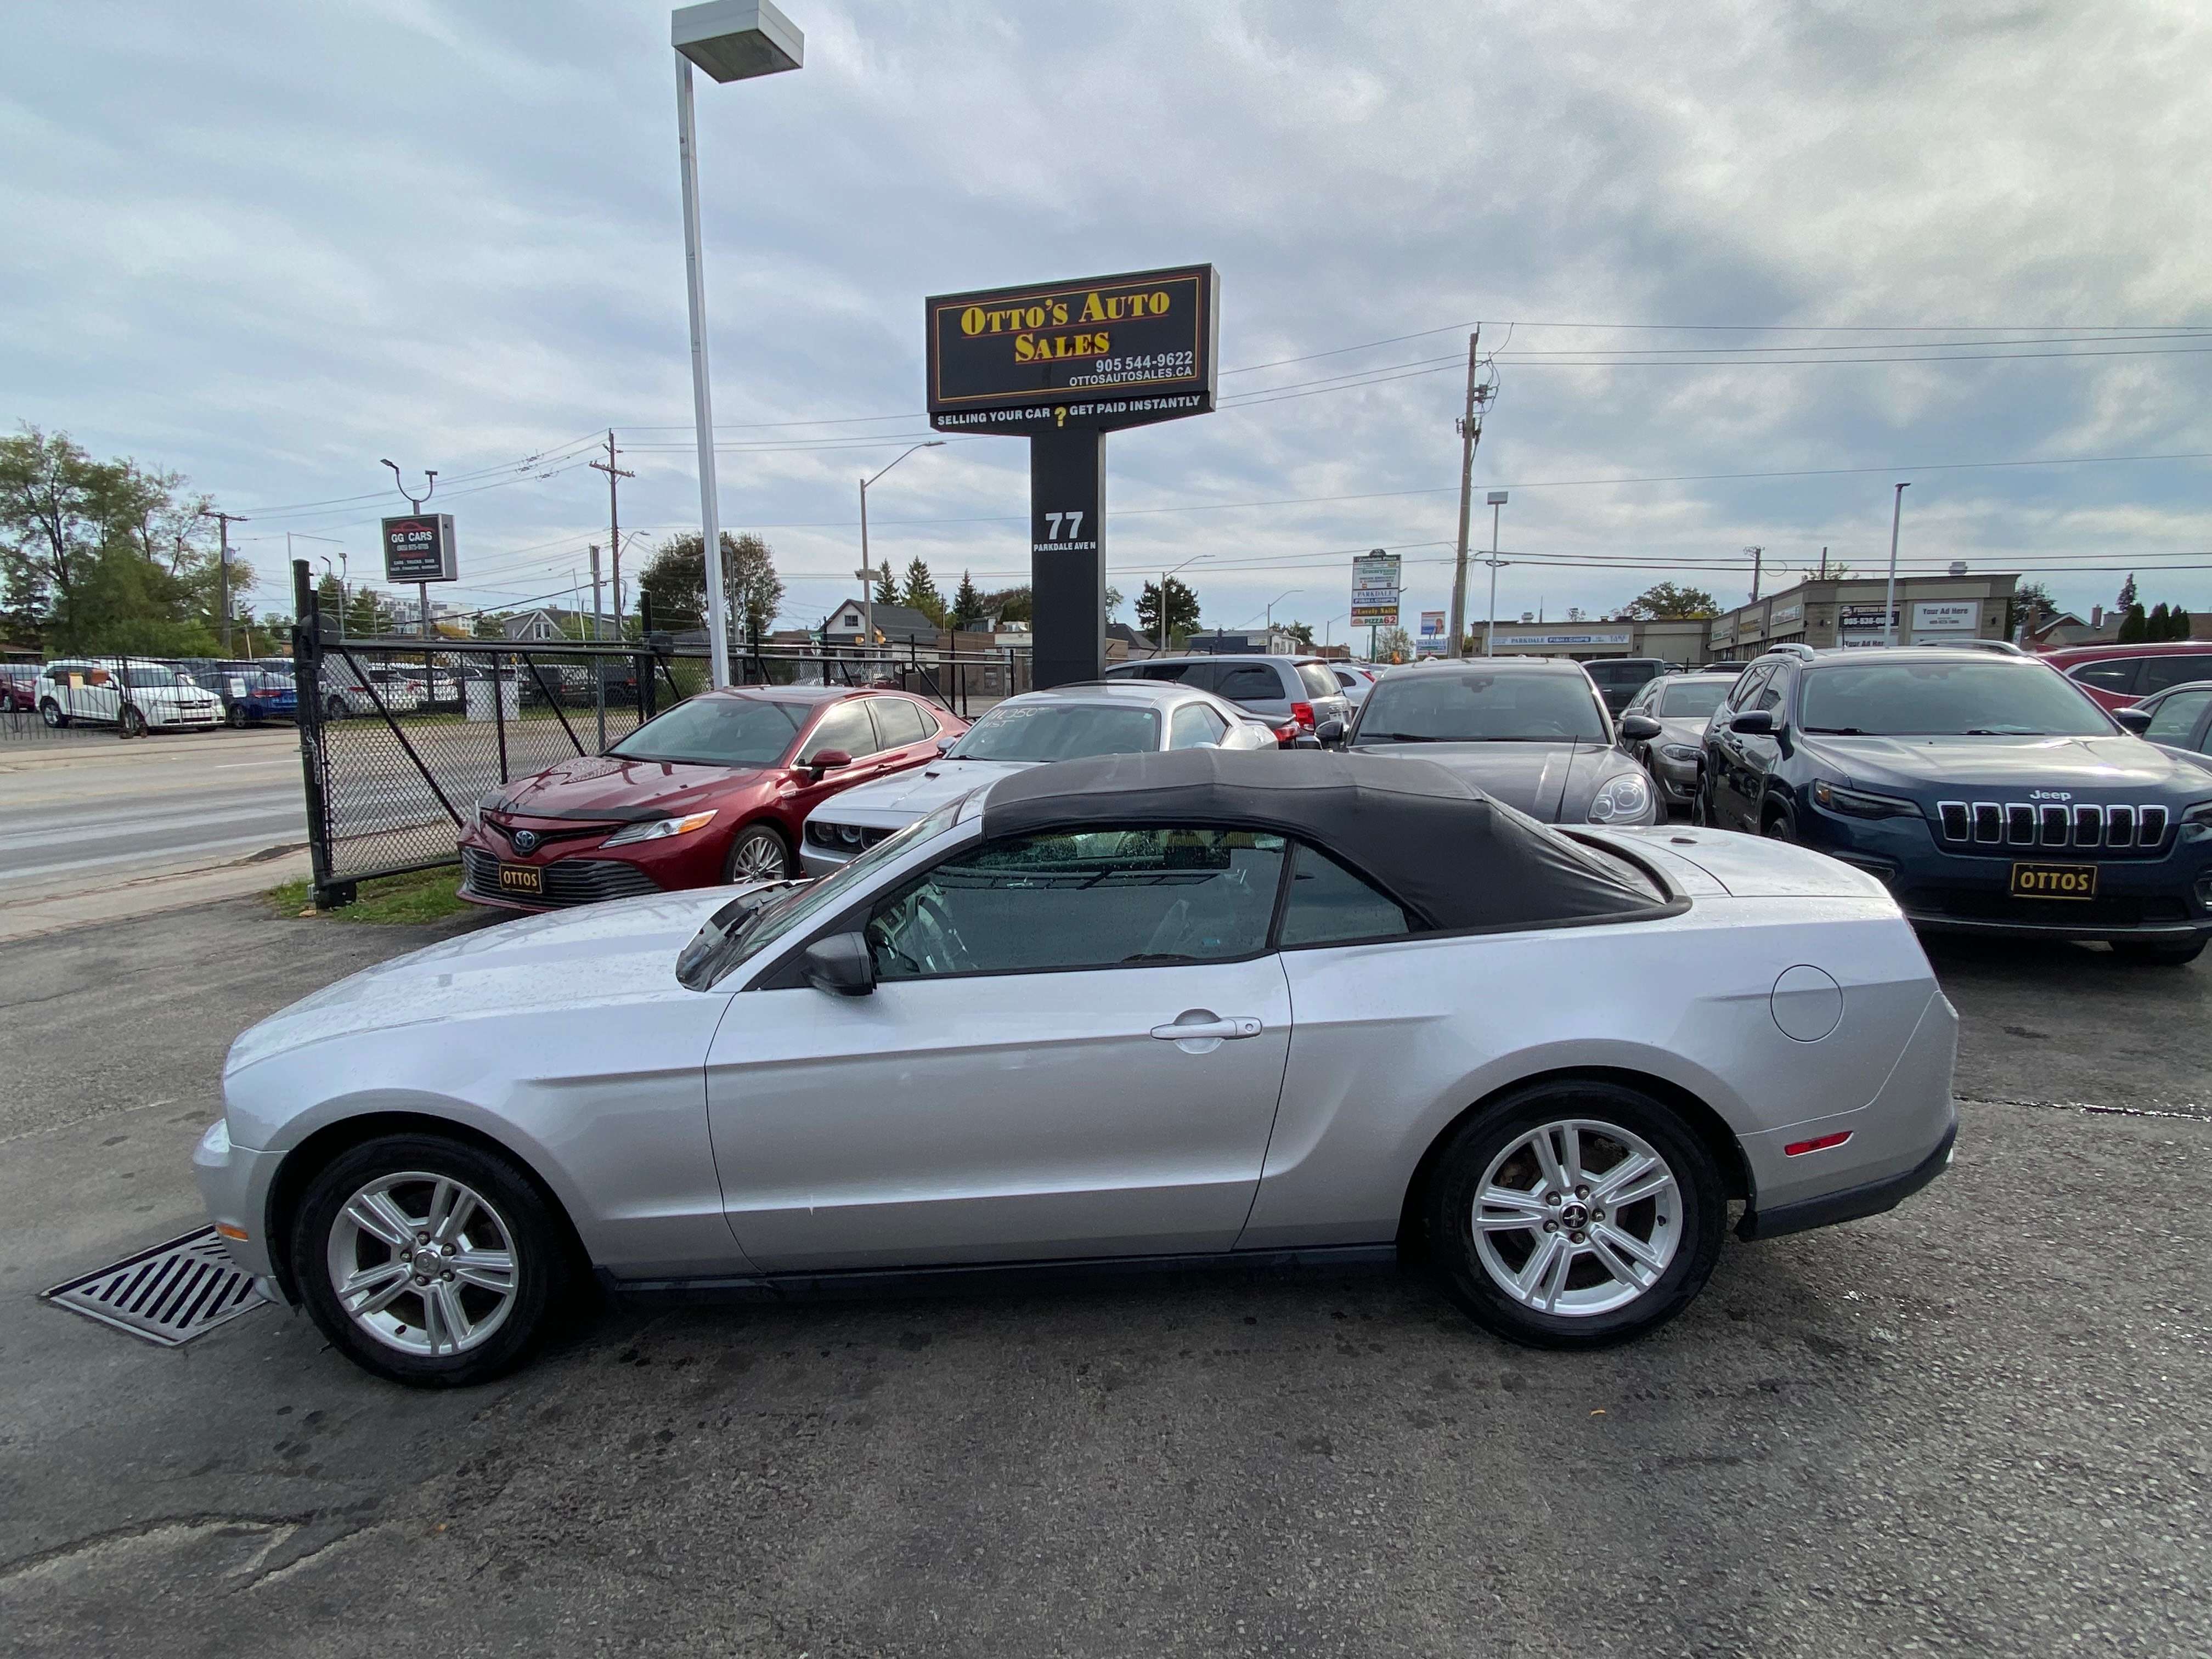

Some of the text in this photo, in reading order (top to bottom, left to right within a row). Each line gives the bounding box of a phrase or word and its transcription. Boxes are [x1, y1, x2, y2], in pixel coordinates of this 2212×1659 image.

[1096, 351, 1193, 373] 905 544-9622
[1069, 366, 1192, 386] OTTOSAUTOSALES.CA
[938, 413, 987, 426] SELLING
[989, 410, 1024, 422] YOUR
[1025, 408, 1050, 419] CAR
[1069, 404, 1094, 415] GET
[1097, 402, 1126, 414] PAID
[1129, 395, 1201, 411] INSTANTLY
[1045, 511, 1083, 540] 77
[391, 531, 432, 543] GG CARS
[1034, 542, 1073, 552] PARKDALE
[1074, 541, 1089, 550] AVE
[2030, 790, 2071, 801] Jeep
[504, 871, 537, 887] OTTOS
[2020, 871, 2089, 890] OTTOS
